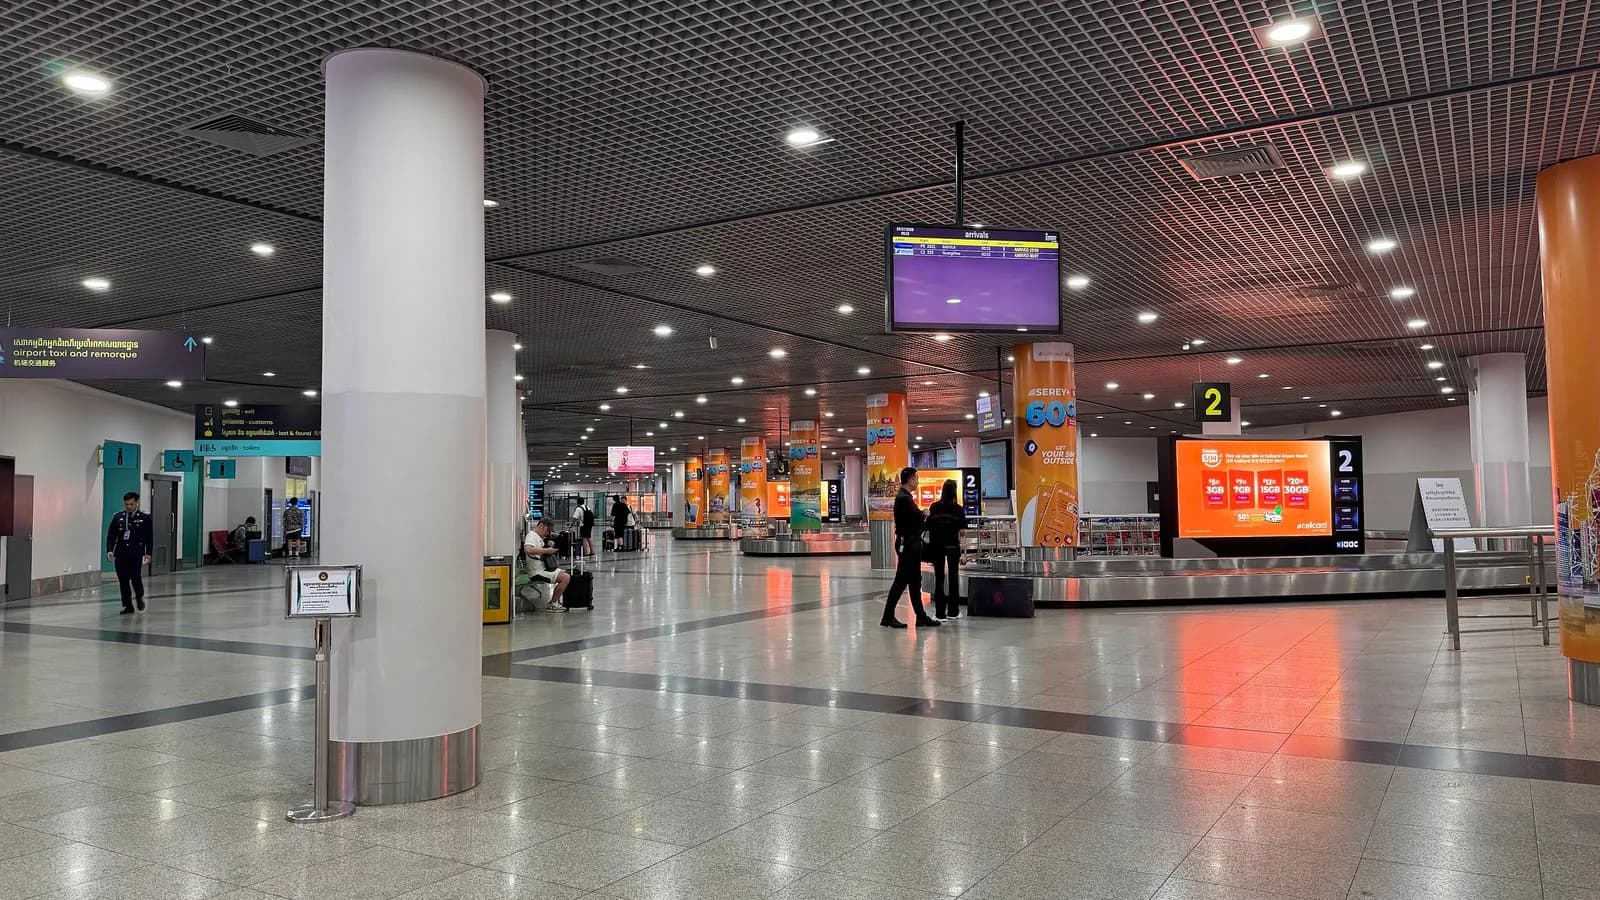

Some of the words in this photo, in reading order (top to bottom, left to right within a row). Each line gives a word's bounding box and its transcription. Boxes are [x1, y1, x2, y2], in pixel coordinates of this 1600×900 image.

[965, 231, 989, 239] arrivals
[13, 348, 46, 358] airport
[49, 349, 68, 358] taxi
[69, 349, 89, 358] and
[90, 351, 138, 360] remorque
[1204, 388, 1222, 416] 2
[1041, 450, 1064, 458] YOUR
[1338, 449, 1353, 472] 2
[778, 462, 785, 473] 3
[966, 475, 976, 488] 2
[830, 484, 838, 493] 3
[1206, 486, 1225, 494] 3GB
[1233, 486, 1251, 494] 7GB
[1260, 486, 1281, 494] 15GB
[1284, 486, 1309, 494] 30GB
